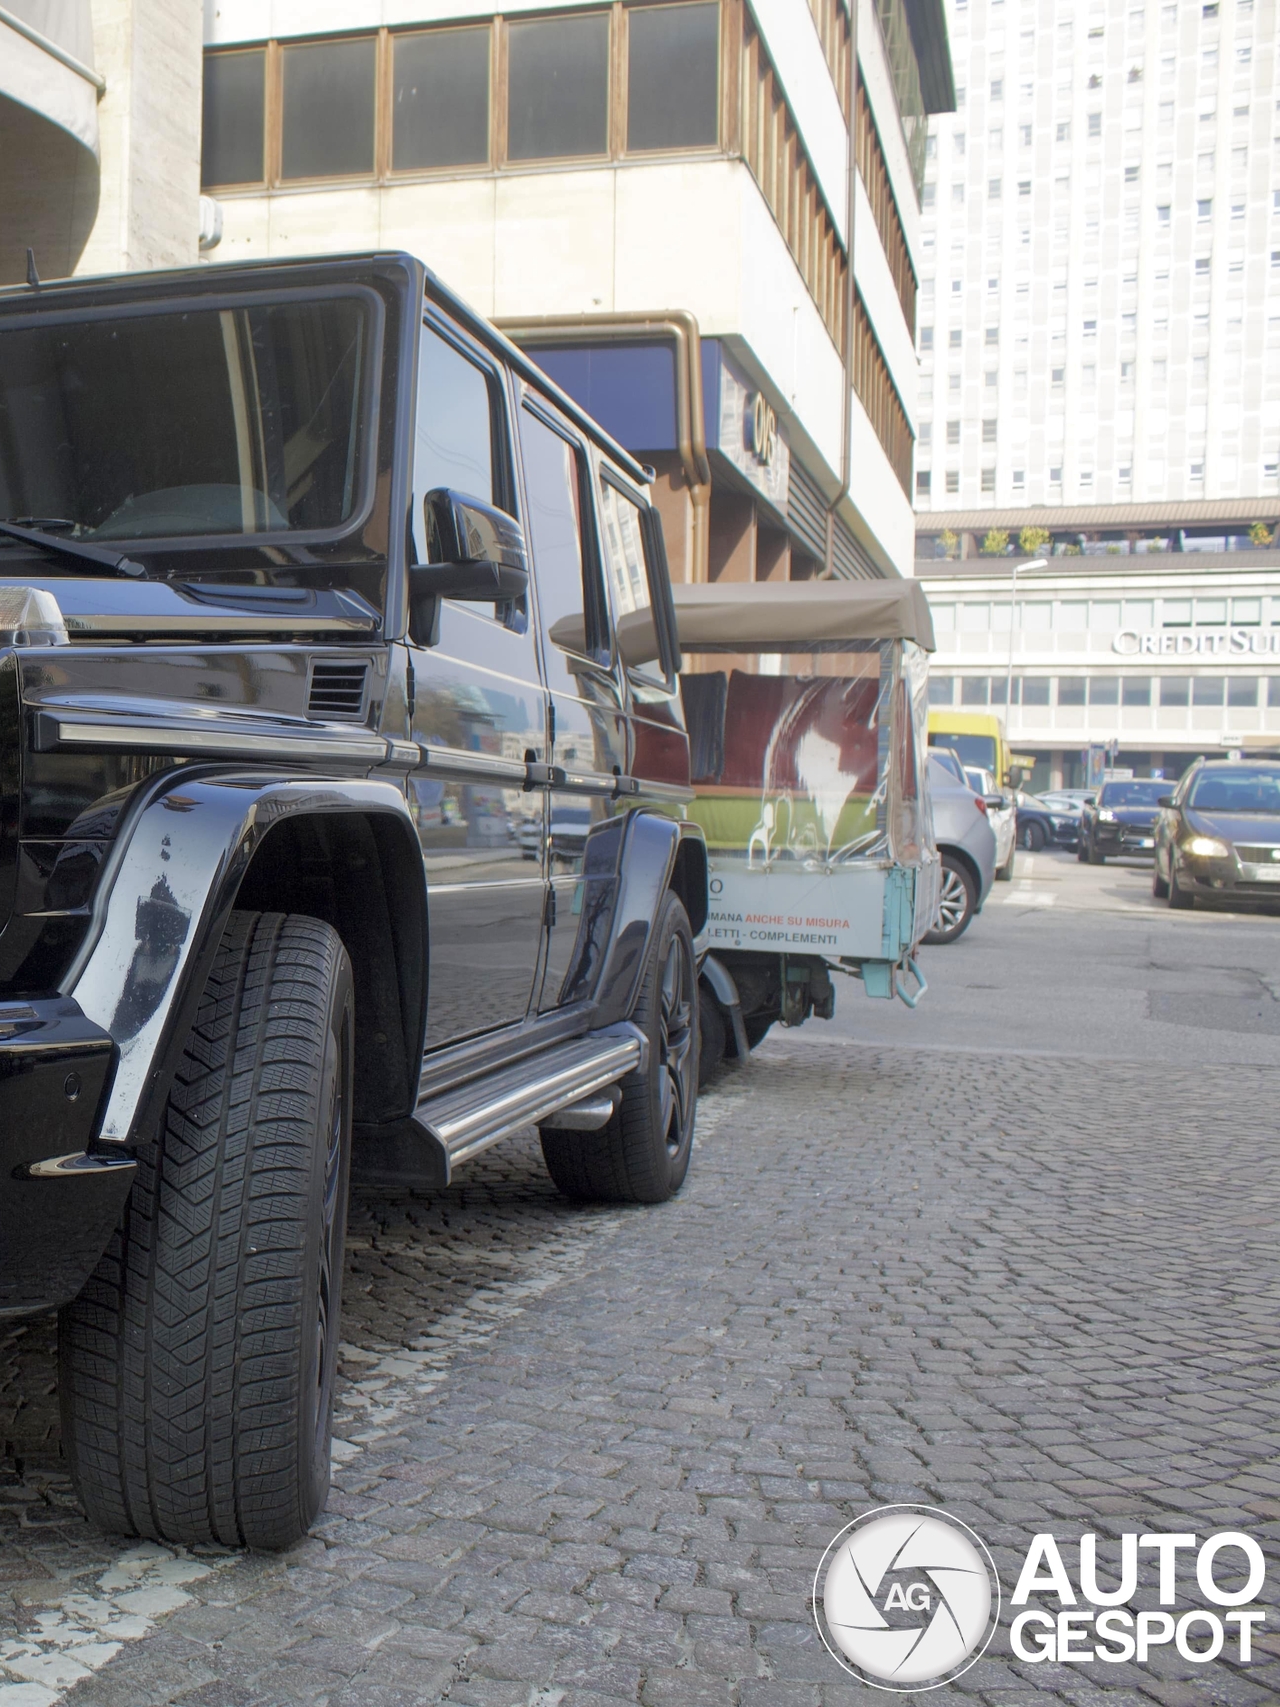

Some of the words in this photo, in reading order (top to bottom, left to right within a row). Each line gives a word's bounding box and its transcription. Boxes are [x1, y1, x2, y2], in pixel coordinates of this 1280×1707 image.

[753, 391, 778, 463] OVS
[1111, 628, 1225, 656] CREDIT
[745, 914, 784, 925] ANCHE
[787, 916, 803, 926] SU
[805, 918, 850, 929] MISURA
[750, 930, 837, 945] COMPLEMENTI
